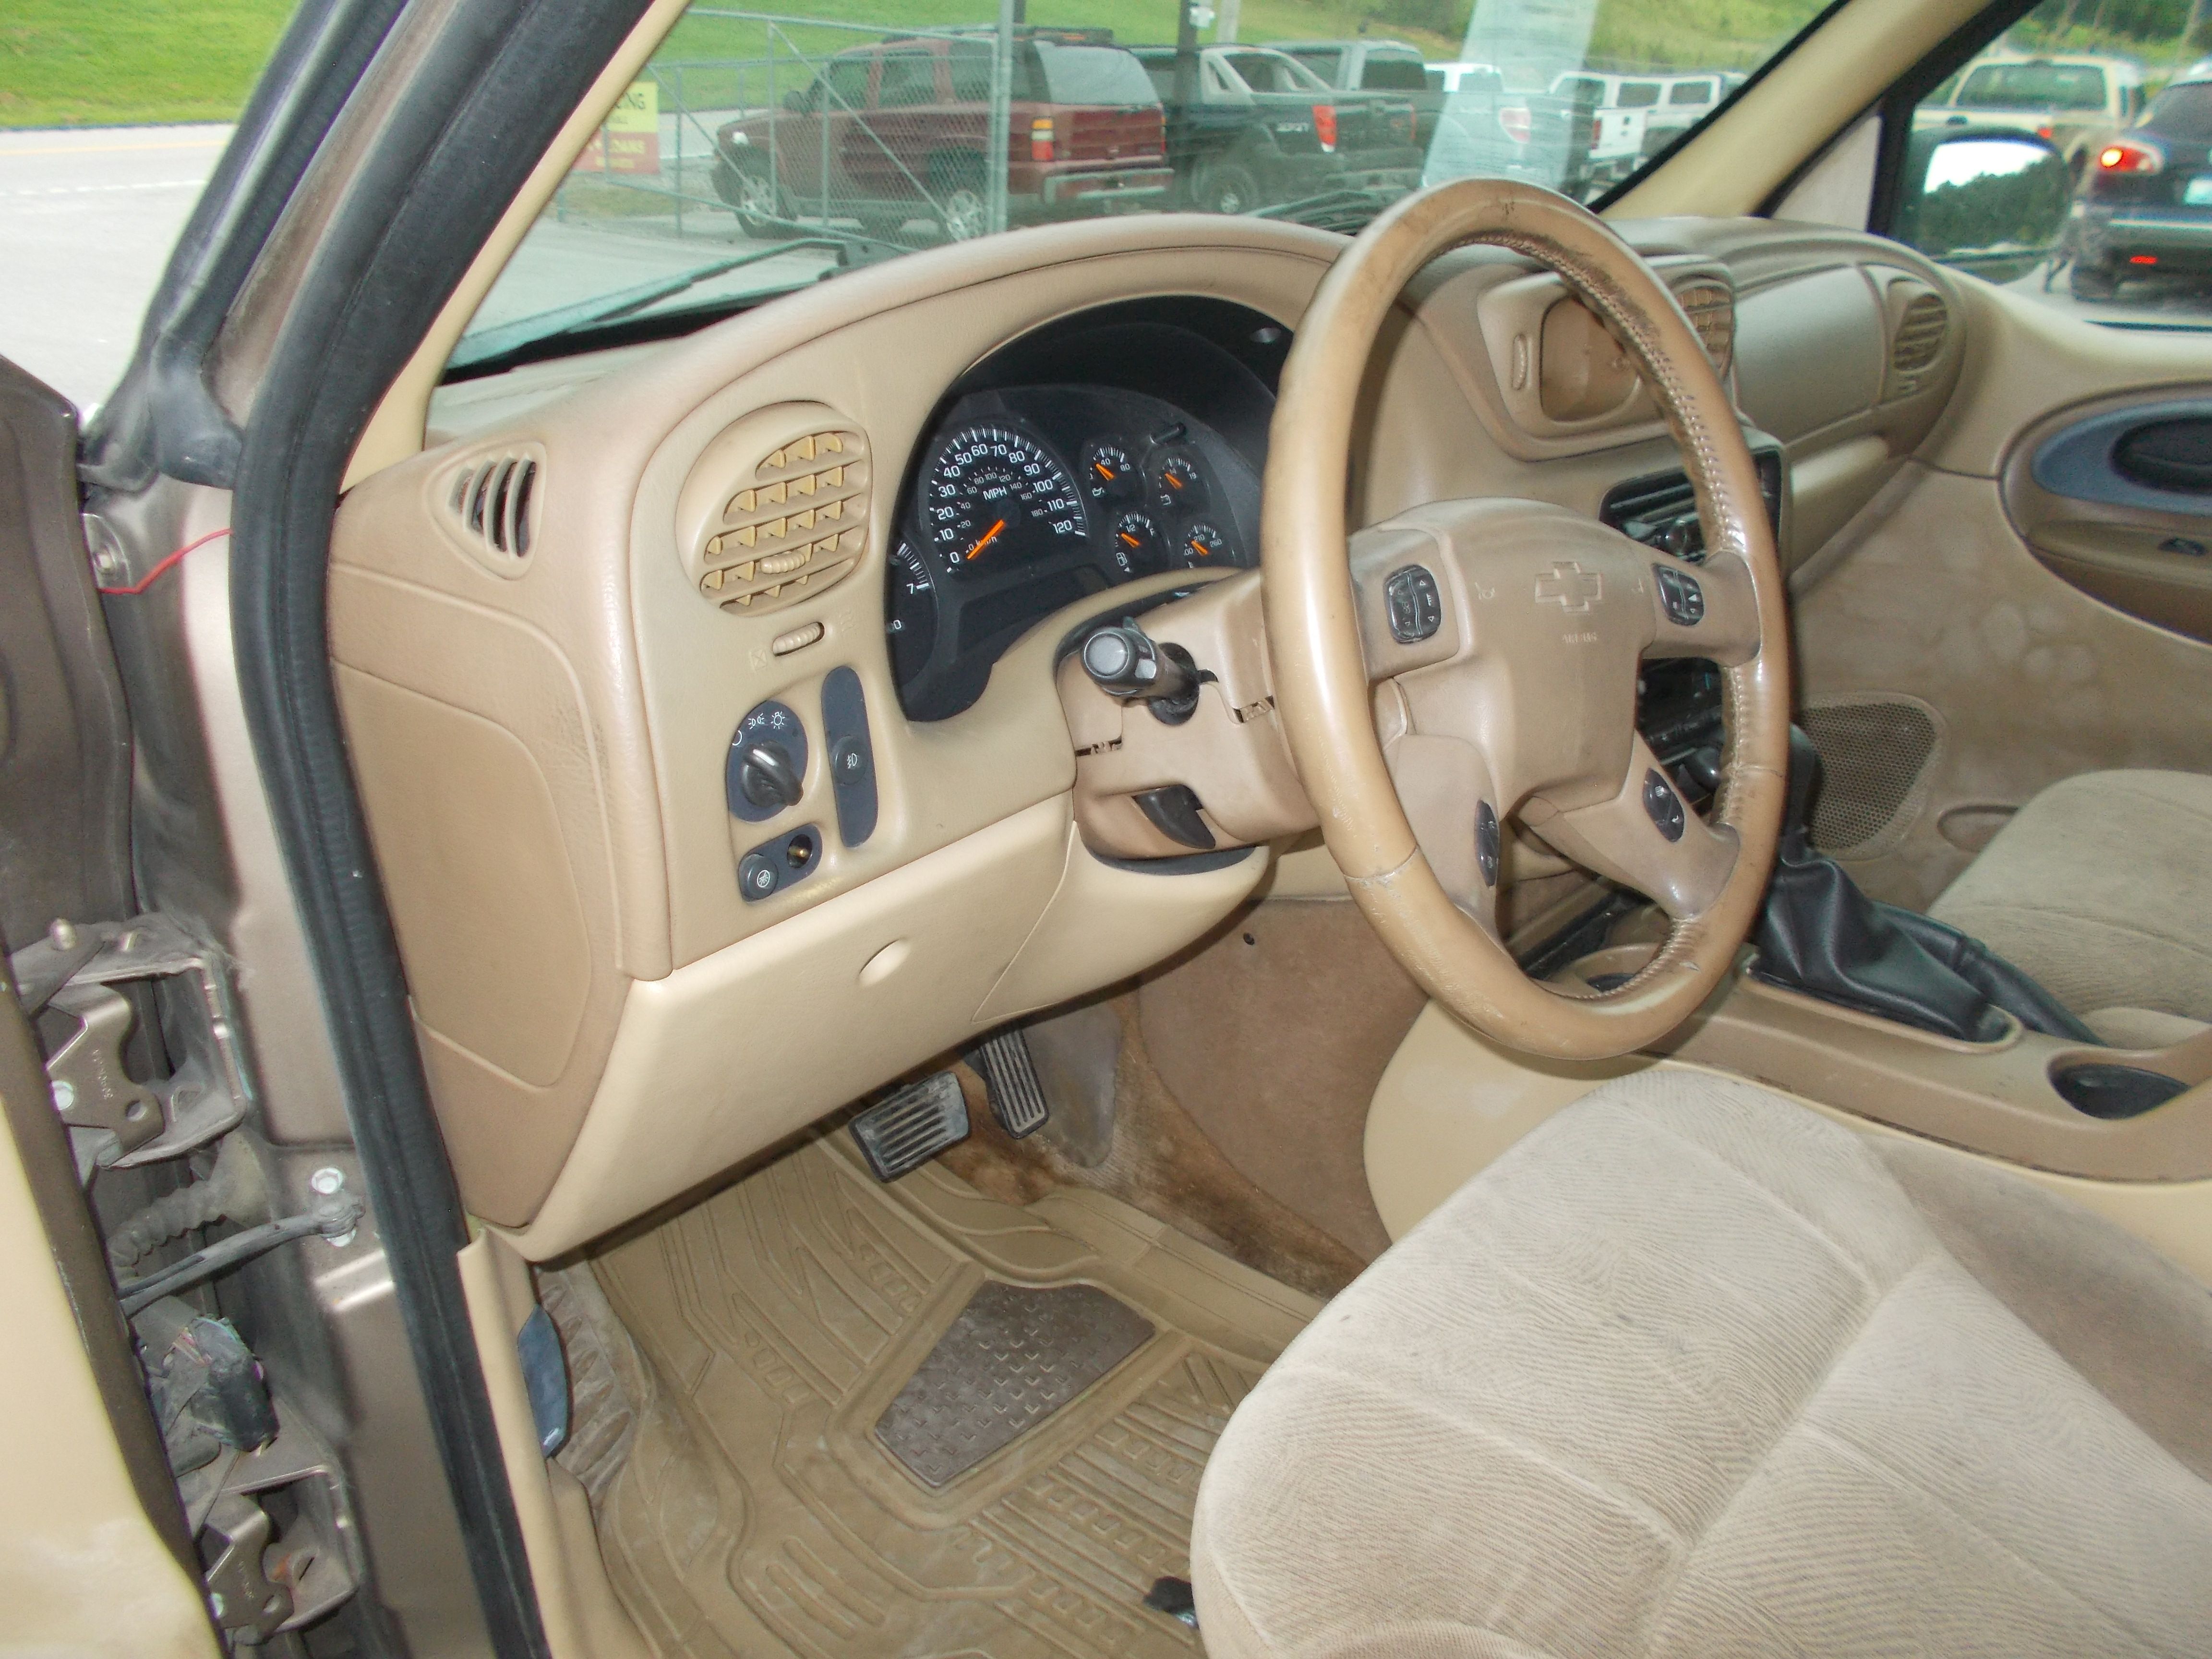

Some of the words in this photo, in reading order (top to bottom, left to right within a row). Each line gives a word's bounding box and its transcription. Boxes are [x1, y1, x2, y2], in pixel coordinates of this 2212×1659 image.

[971, 444, 988, 456] 60
[990, 445, 1007, 457] 70
[954, 452, 973, 465] 50
[1009, 451, 1025, 463] 80
[943, 466, 961, 478] 40
[1024, 463, 1040, 476] 90
[999, 474, 1011, 482] 120
[938, 484, 956, 497] 30
[1033, 479, 1053, 493] 100
[983, 486, 1007, 500] MPH
[1047, 498, 1065, 511] 110
[937, 506, 954, 520] 20
[1031, 509, 1043, 517] 180
[961, 520, 971, 528] 20
[1053, 520, 1072, 534] 120
[1126, 524, 1136, 532] 1/2
[939, 528, 954, 541] 10
[1210, 539, 1222, 547] 260
[950, 552, 960, 564] 0
[906, 583, 914, 595] 7
